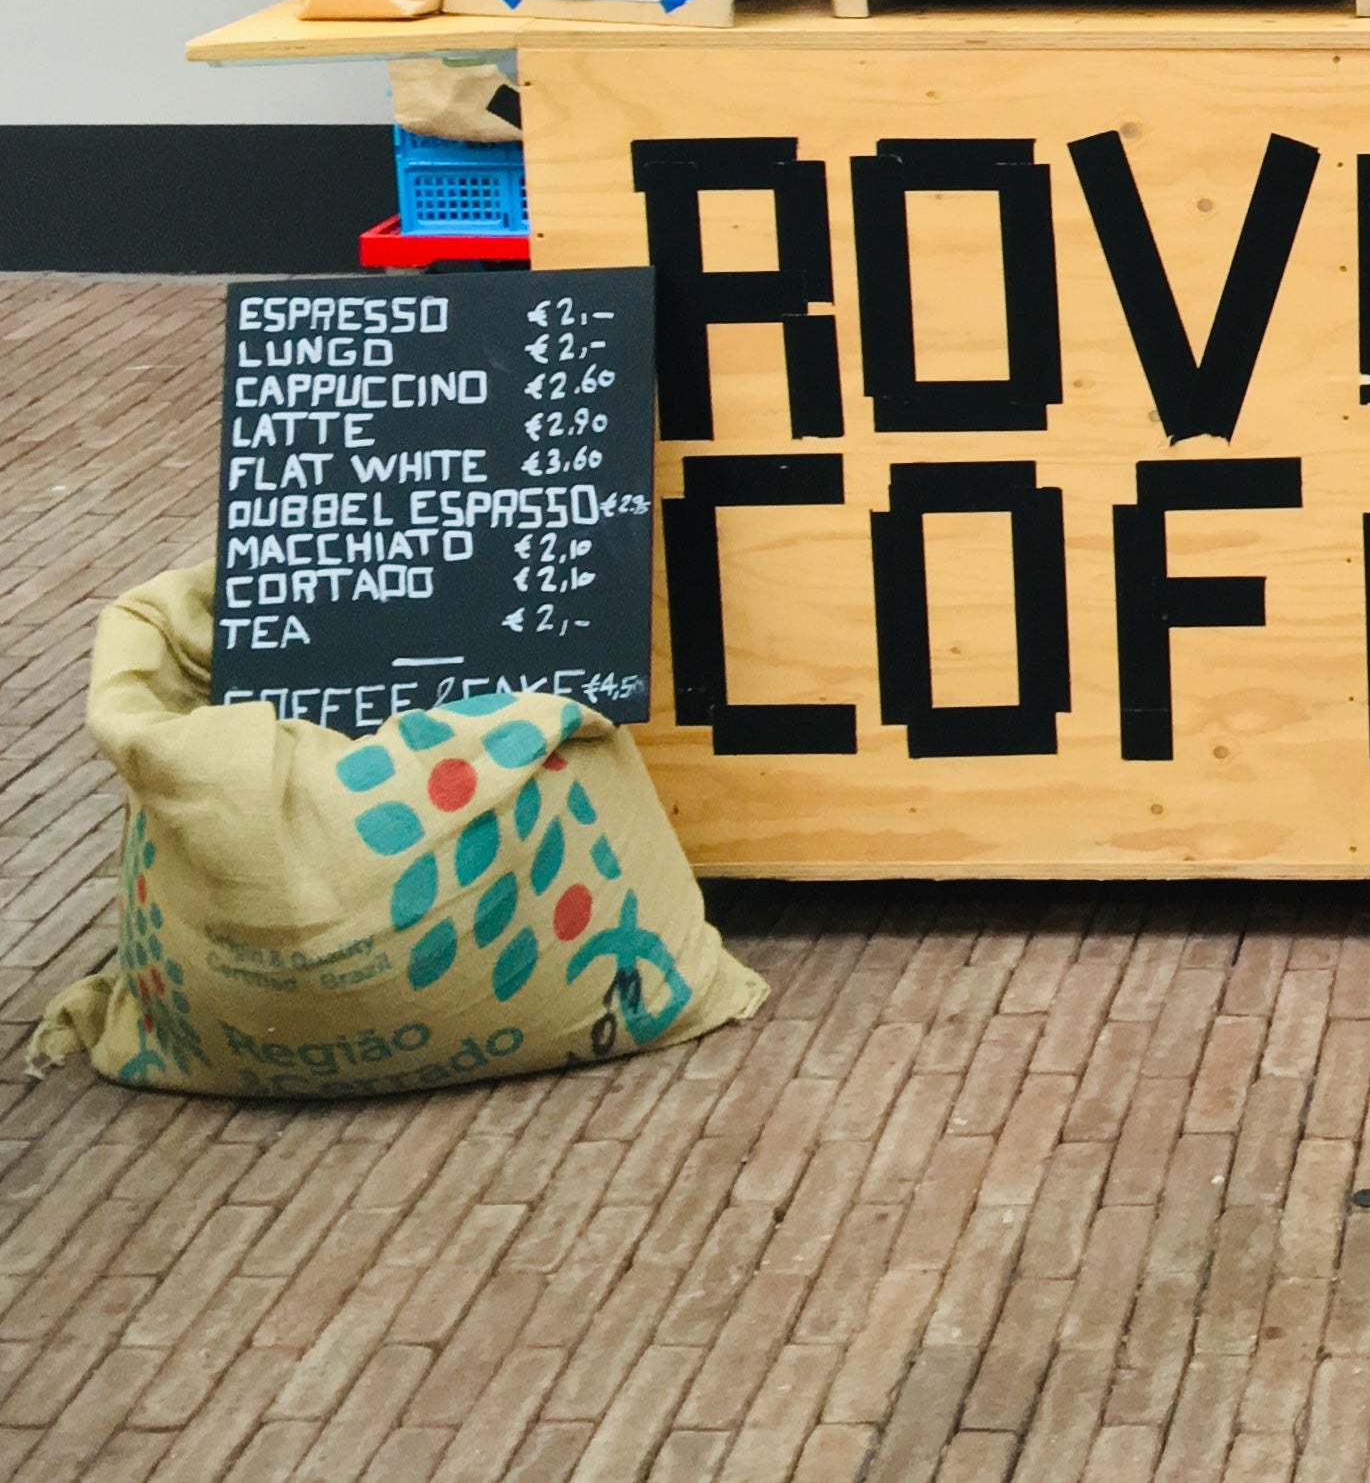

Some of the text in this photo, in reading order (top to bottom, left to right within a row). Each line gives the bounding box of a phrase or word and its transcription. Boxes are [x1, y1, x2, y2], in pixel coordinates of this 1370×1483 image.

[239, 296, 448, 333] ESPRESSO
[239, 336, 393, 367] LUNGO
[236, 371, 487, 408] CAPPUCCINO
[233, 412, 375, 448] LATTE
[229, 453, 333, 491] FLAT
[351, 449, 487, 483] WHITE
[227, 528, 473, 571] MACCHIATO
[226, 563, 433, 608] CORTADO
[220, 615, 310, 649] TEA
